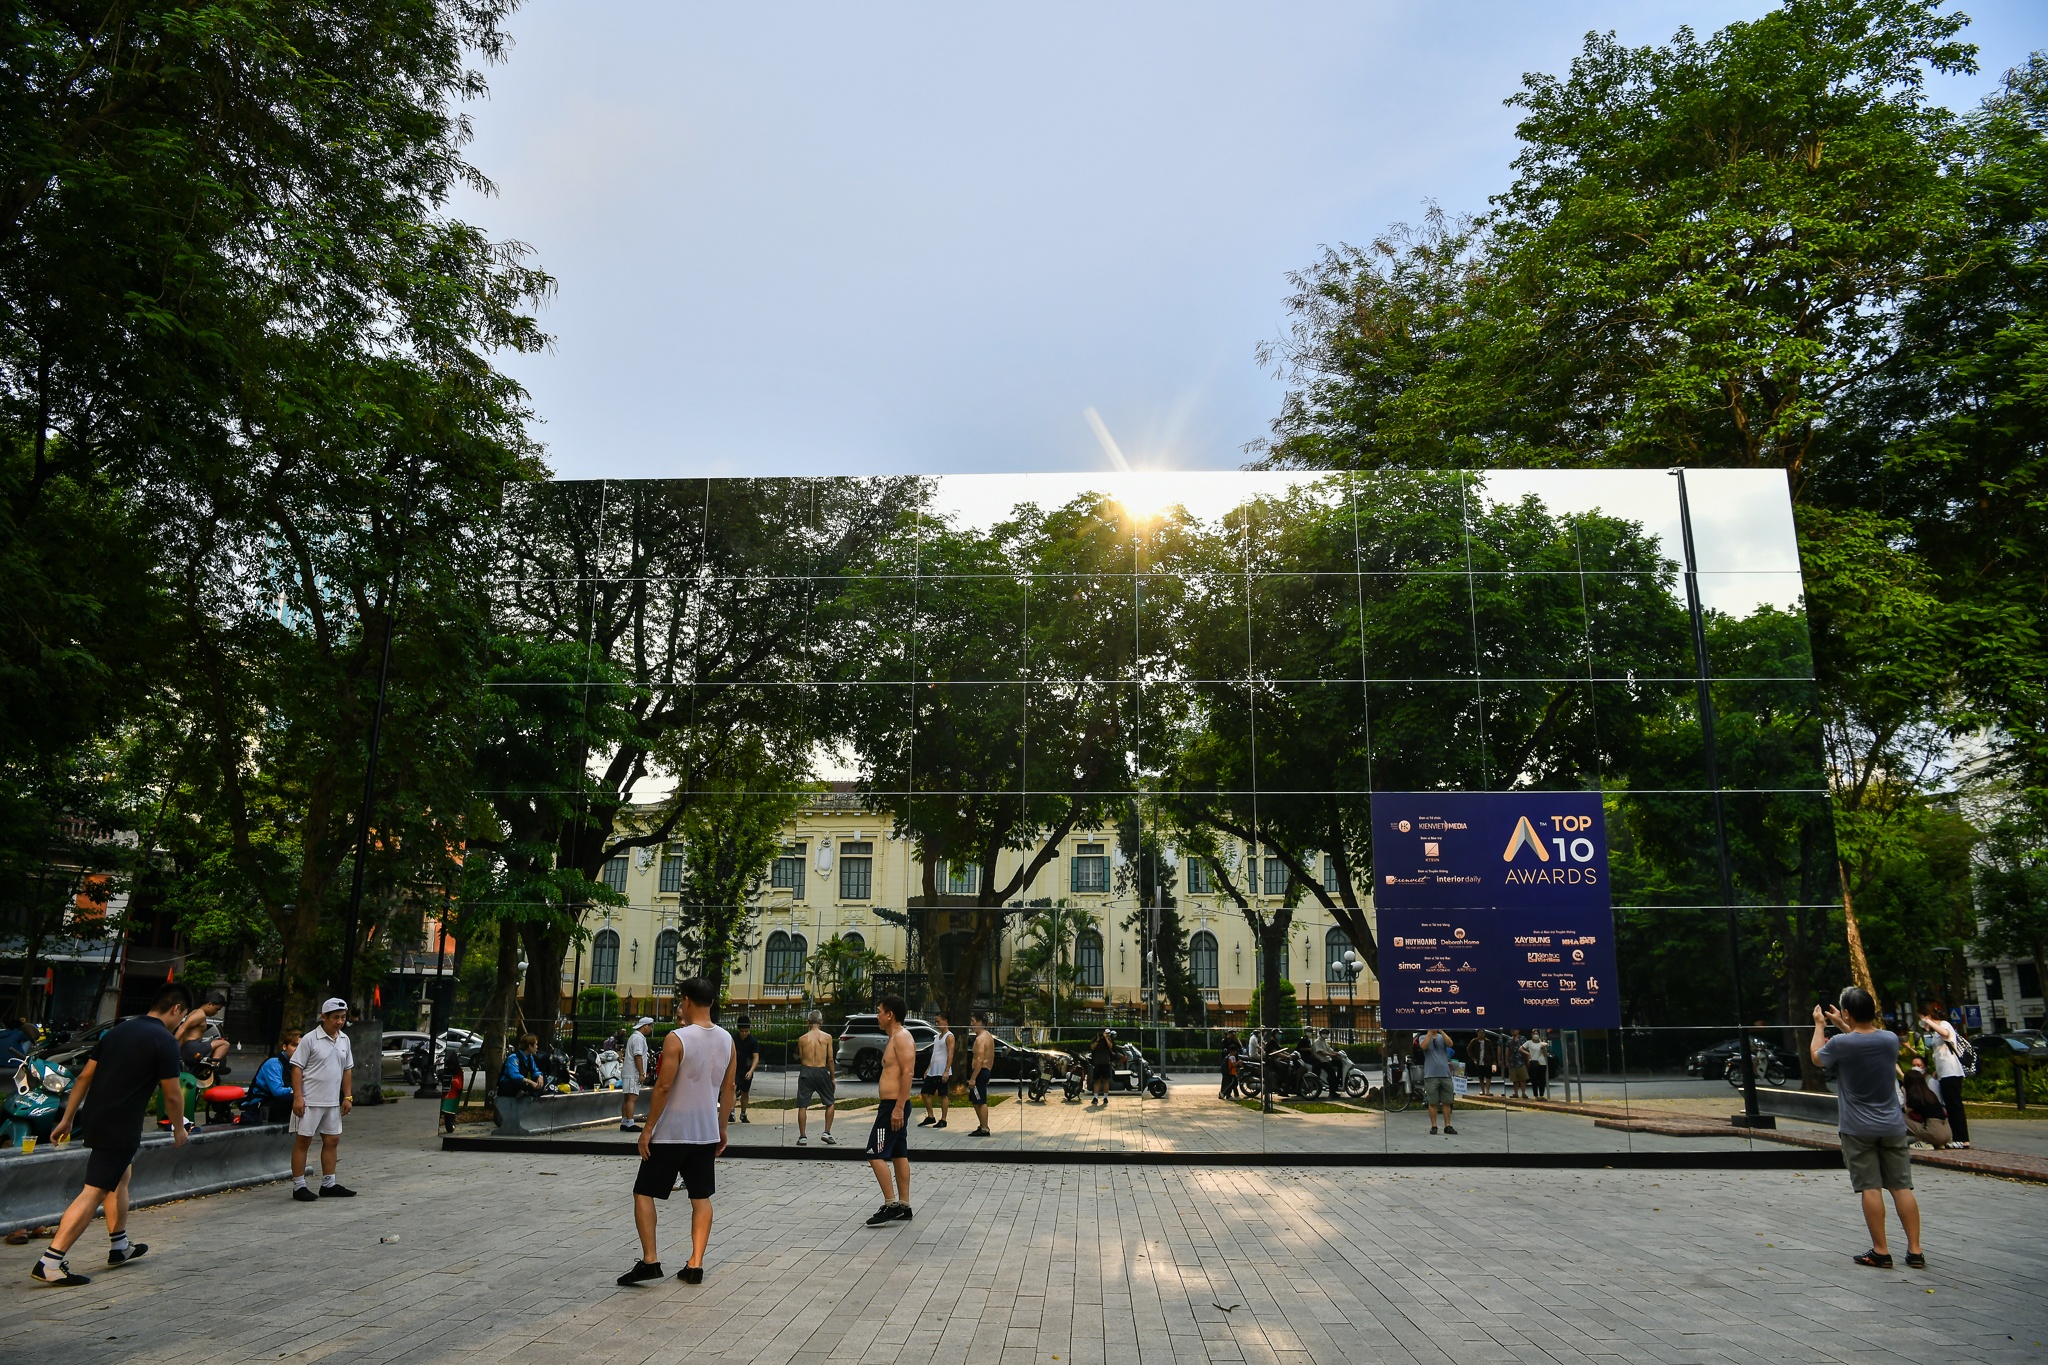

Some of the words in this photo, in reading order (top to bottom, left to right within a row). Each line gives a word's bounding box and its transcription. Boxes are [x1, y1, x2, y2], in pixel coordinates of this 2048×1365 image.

[1551, 816, 1592, 832] TOP
[1552, 838, 1594, 862] 10
[1505, 868, 1597, 884] AWARDS
[1398, 961, 1421, 969] simon
